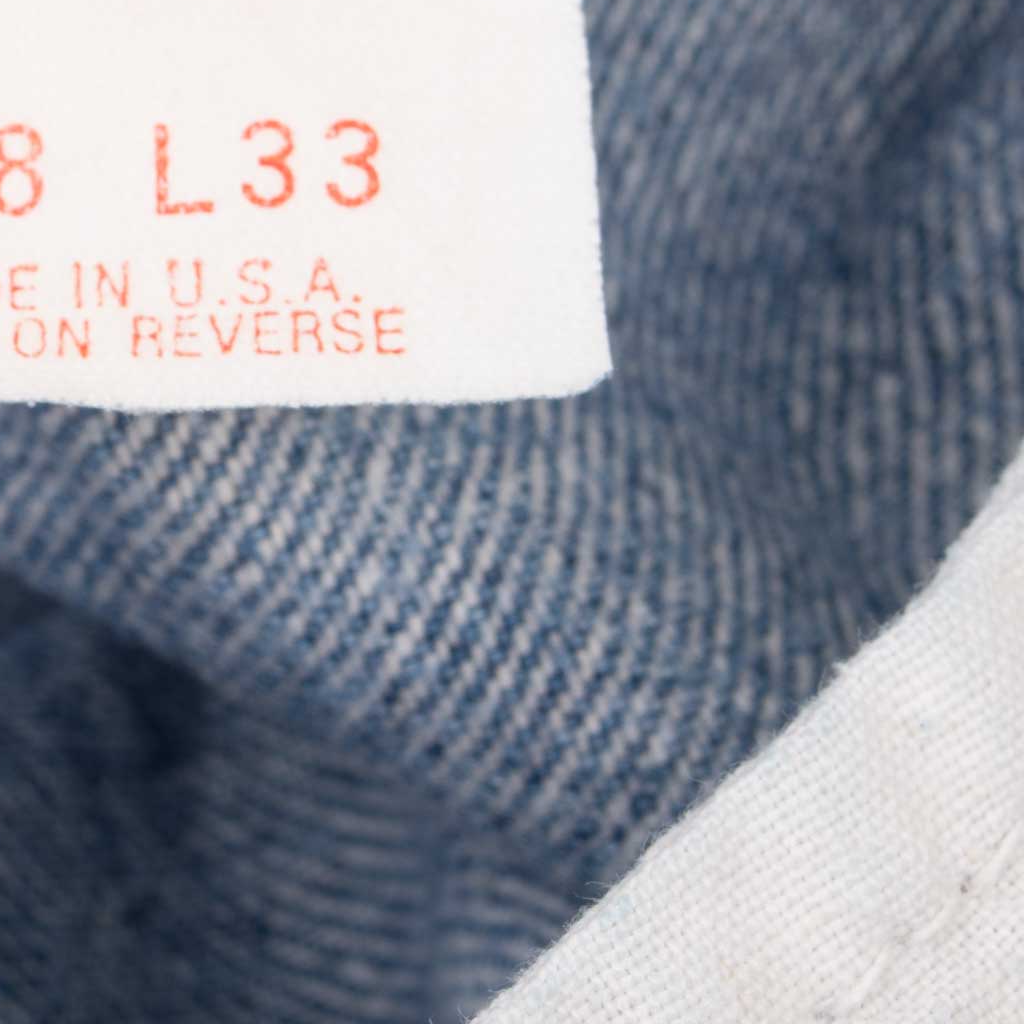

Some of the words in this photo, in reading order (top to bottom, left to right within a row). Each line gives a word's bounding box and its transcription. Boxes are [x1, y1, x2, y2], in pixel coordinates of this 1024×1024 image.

[153, 118, 382, 216] L33
[72, 260, 131, 309] IN
[166, 256, 364, 308] U.S.A.
[13, 317, 91, 360] ON
[131, 307, 408, 358] REVERSE
